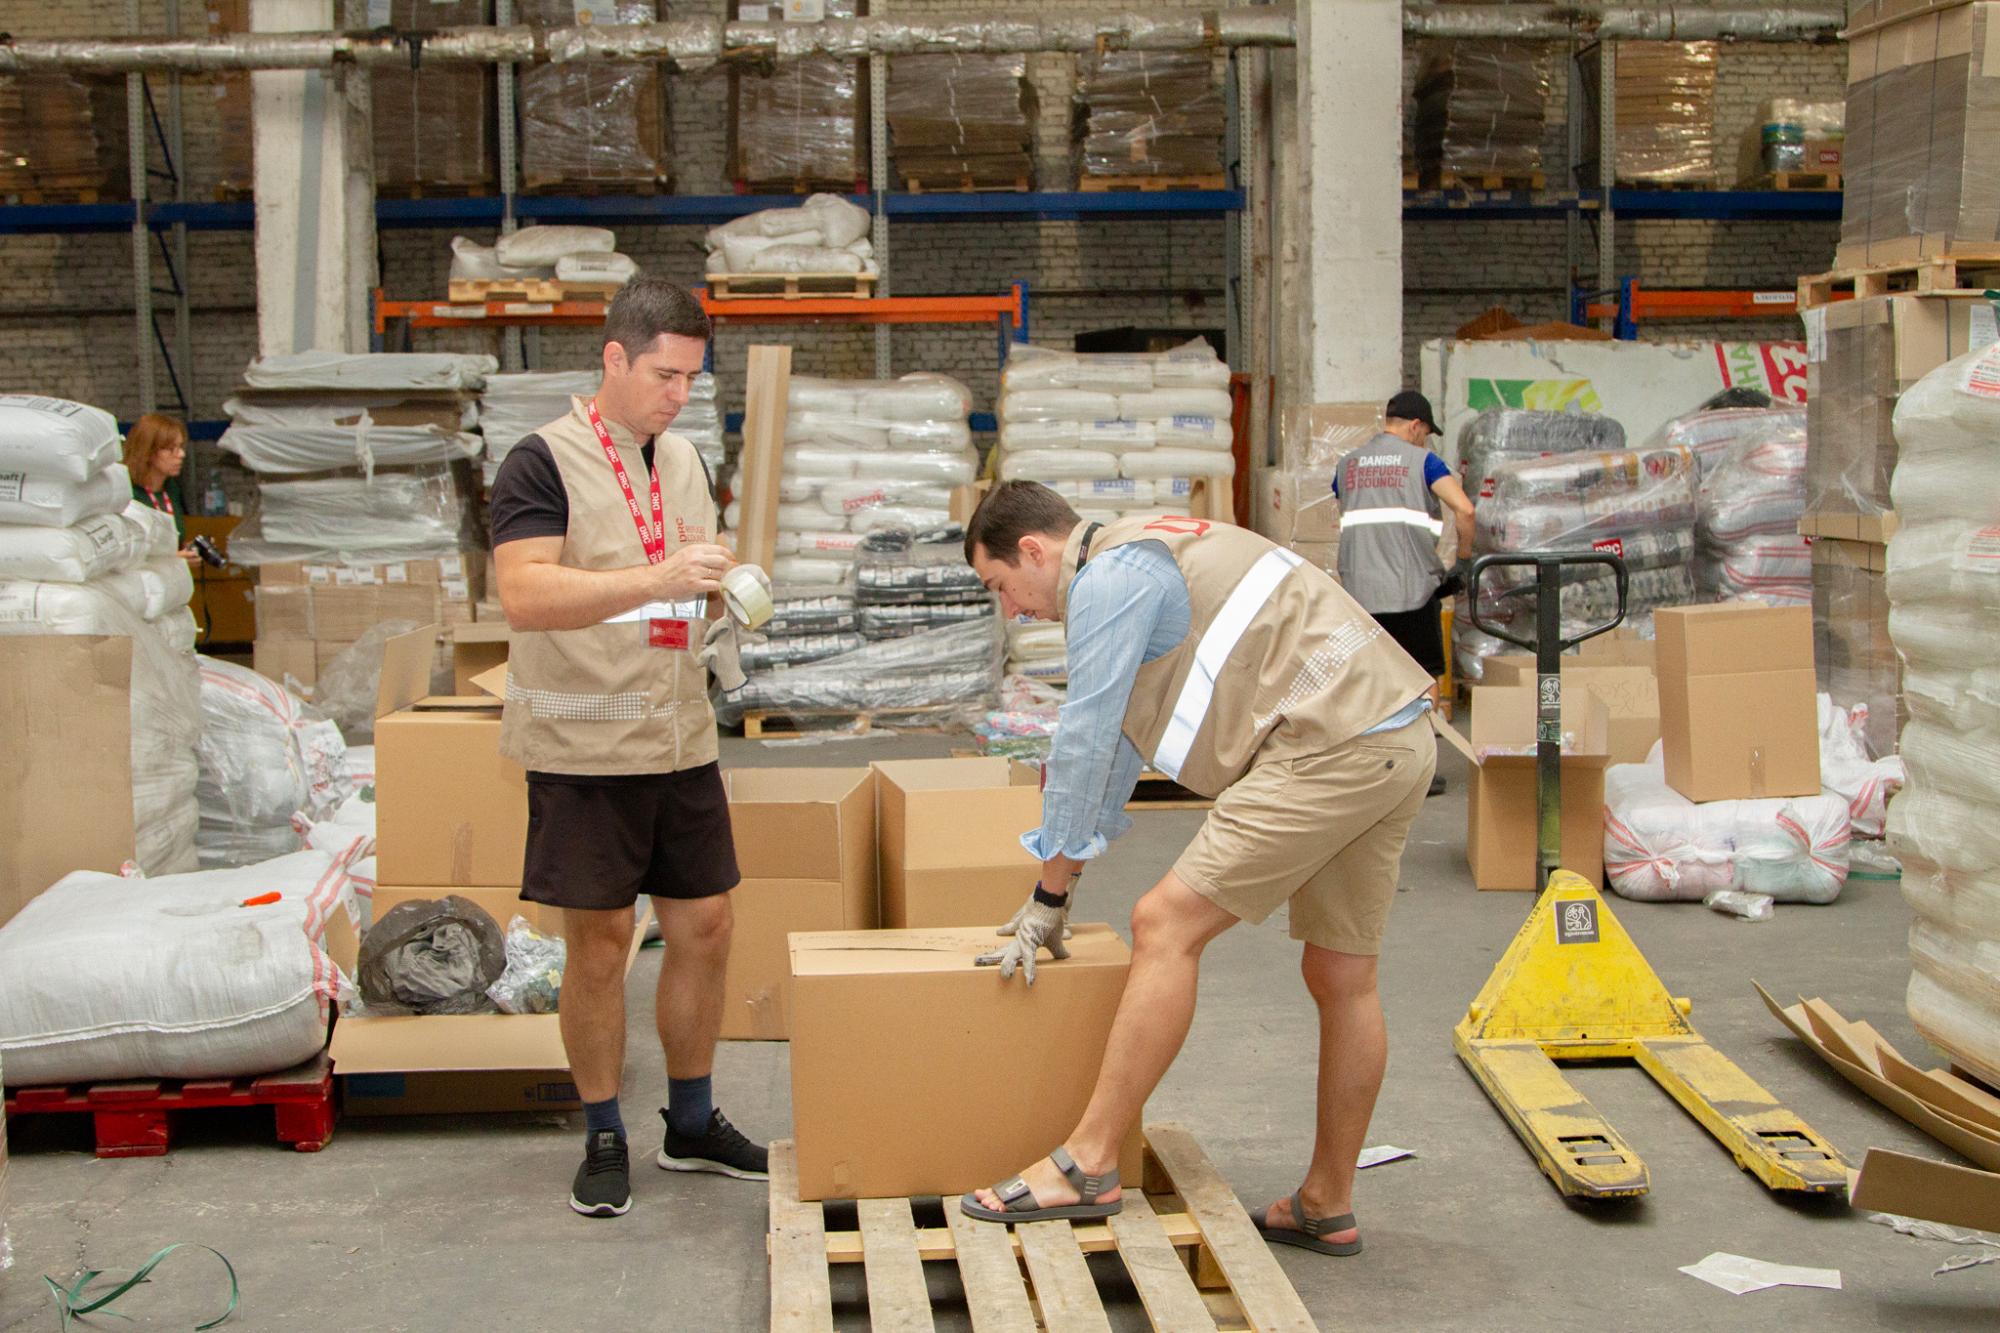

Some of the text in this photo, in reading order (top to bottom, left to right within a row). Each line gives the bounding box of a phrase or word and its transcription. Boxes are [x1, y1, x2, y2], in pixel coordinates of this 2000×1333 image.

[594, 420, 608, 438] DRC
[606, 446, 619, 463] DRC
[1359, 455, 1402, 467] DANISH
[617, 471, 630, 490] DRC
[1358, 467, 1409, 477] REFUGEE
[1358, 477, 1405, 489] COUNCIL
[628, 498, 641, 517] DRC
[651, 492, 661, 511] DRC
[639, 525, 651, 544] DRC
[654, 521, 663, 539] DRC
[675, 517, 688, 543] DRC
